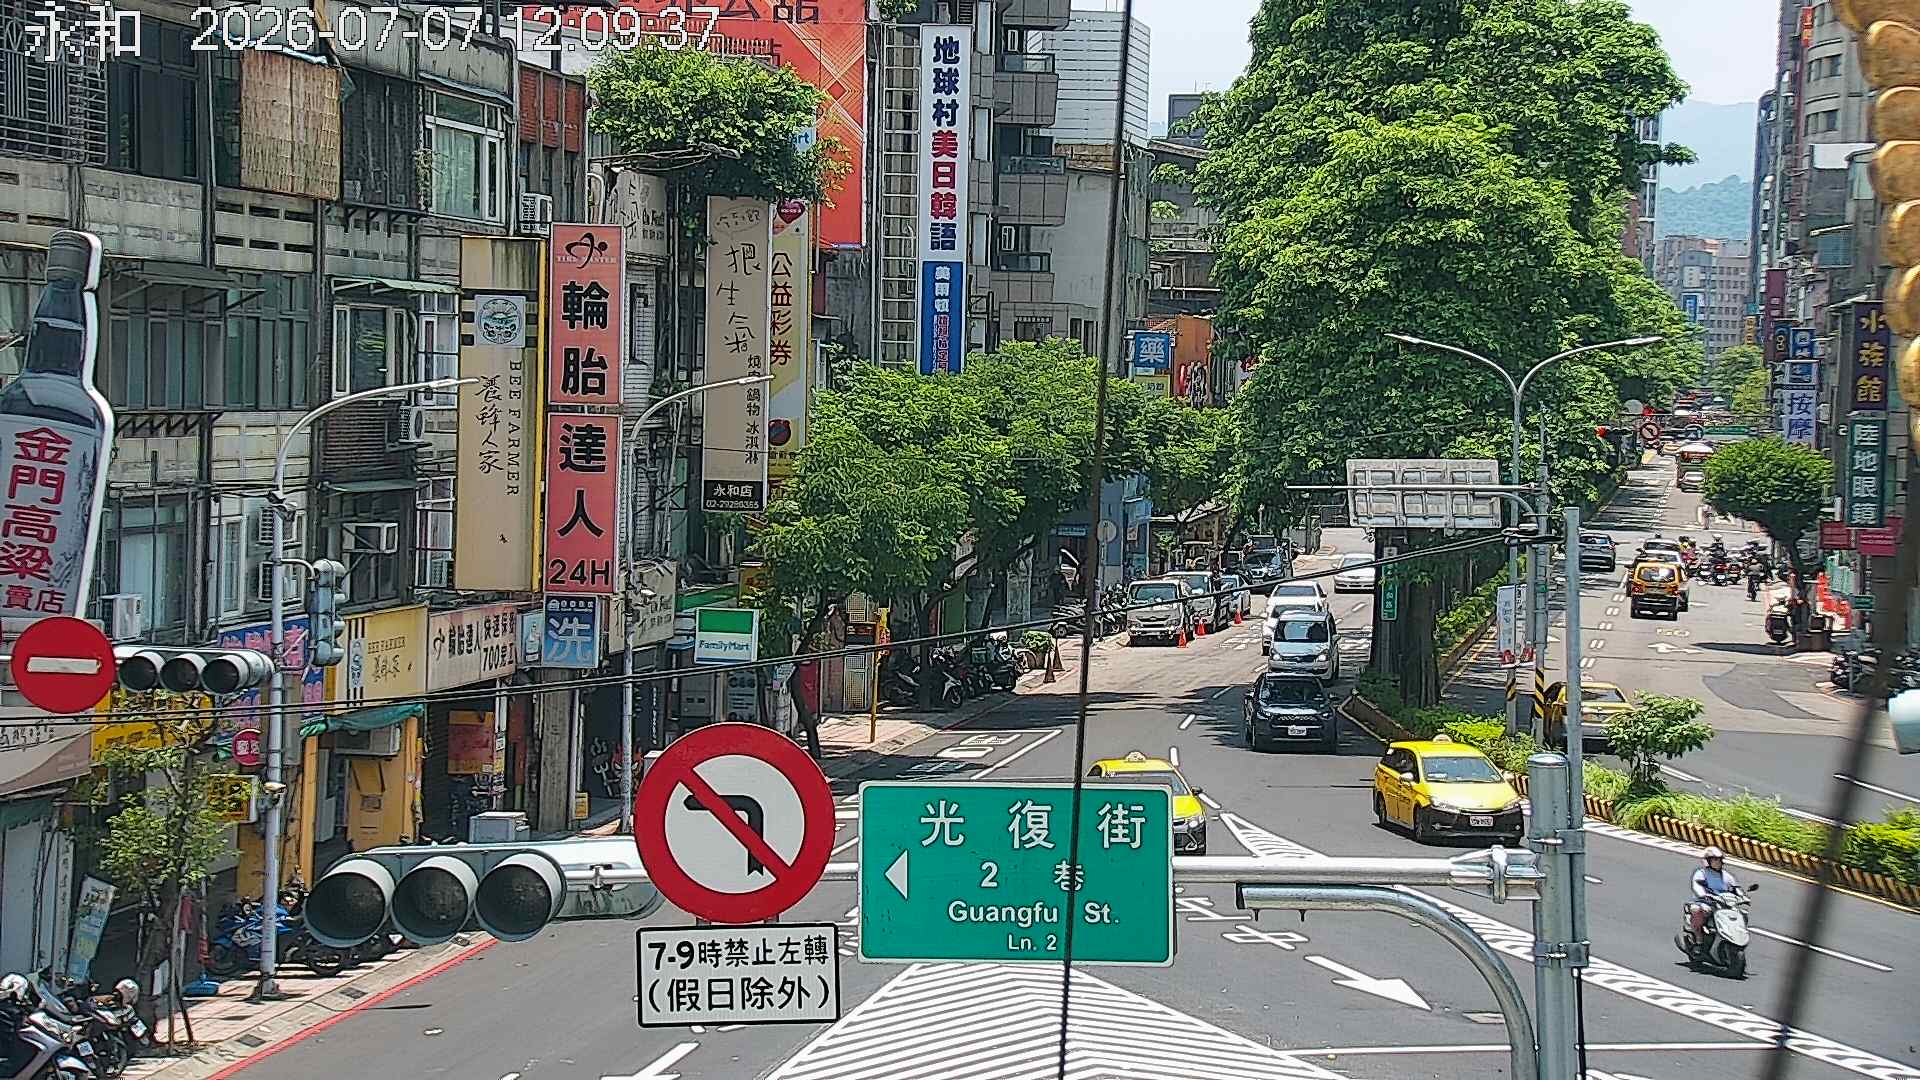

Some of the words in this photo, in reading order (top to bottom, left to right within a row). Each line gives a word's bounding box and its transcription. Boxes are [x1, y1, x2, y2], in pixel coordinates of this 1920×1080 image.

[930, 36, 961, 252] 地球村美日韓語
[770, 252, 793, 366] 公益彩券
[560, 280, 610, 396] 輪胎
[1139, 336, 1166, 364] 藥
[1856, 309, 1885, 402] 水族館
[508, 359, 522, 400] BEE
[474, 374, 503, 475] 養蜂人家
[506, 407, 522, 496] FARMER
[556, 422, 607, 538] 達人
[713, 484, 754, 498] 永和店
[548, 558, 610, 586] 24H
[0, 583, 67, 615] 賣店
[548, 616, 592, 662] 洗
[699, 639, 750, 652] FamilyMart
[920, 800, 1146, 849] 光復街
[948, 901, 1059, 928] Guangfu
[1083, 902, 1121, 924] St.
[647, 935, 830, 971] 7-9時禁止左轉
[1007, 934, 1037, 951] Ln.
[1046, 934, 1057, 951] 2
[648, 975, 830, 1013] (假日除外)
